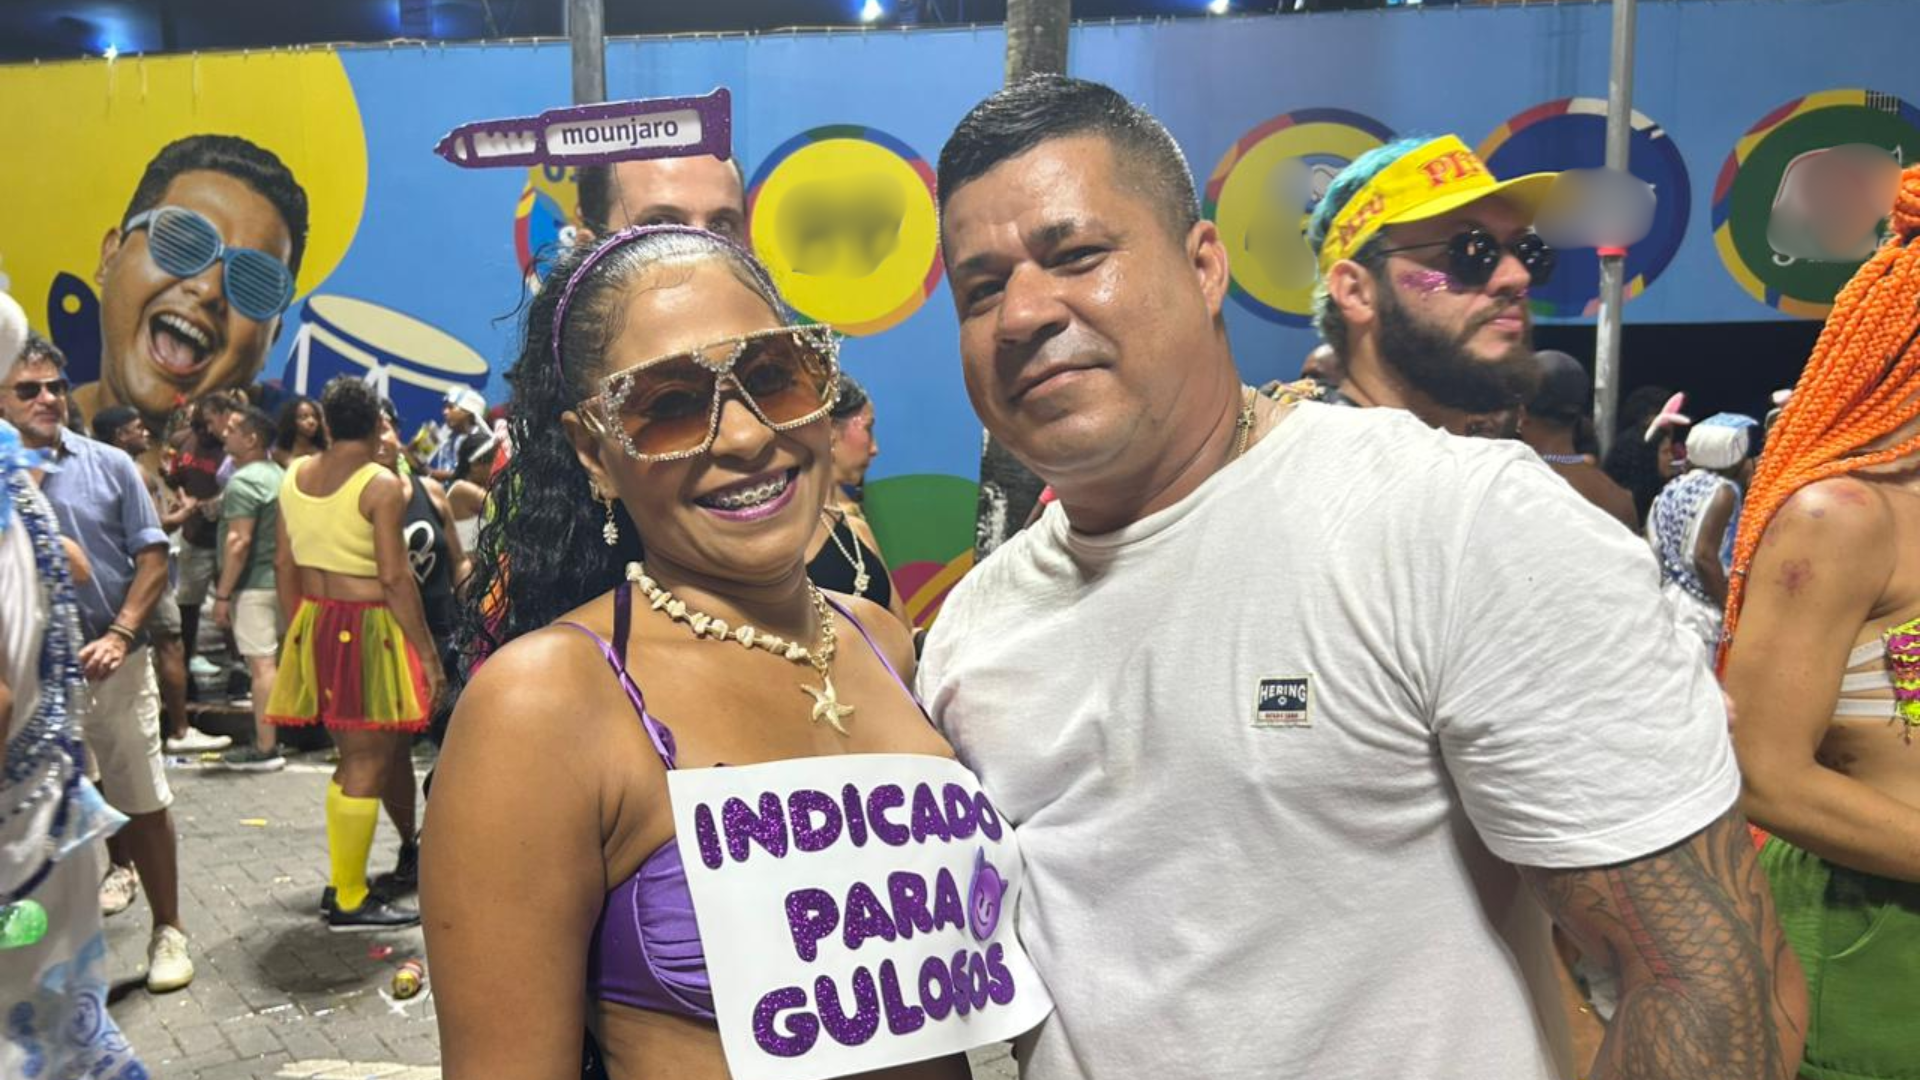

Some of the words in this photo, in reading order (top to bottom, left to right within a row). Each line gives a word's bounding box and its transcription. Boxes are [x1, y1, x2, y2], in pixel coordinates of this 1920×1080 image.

[561, 117, 679, 146] mounjaro
[1259, 684, 1306, 704] HERING
[694, 782, 1003, 870] INDICADO
[784, 867, 966, 963] PARA
[752, 942, 1016, 1058] GULOSOS
